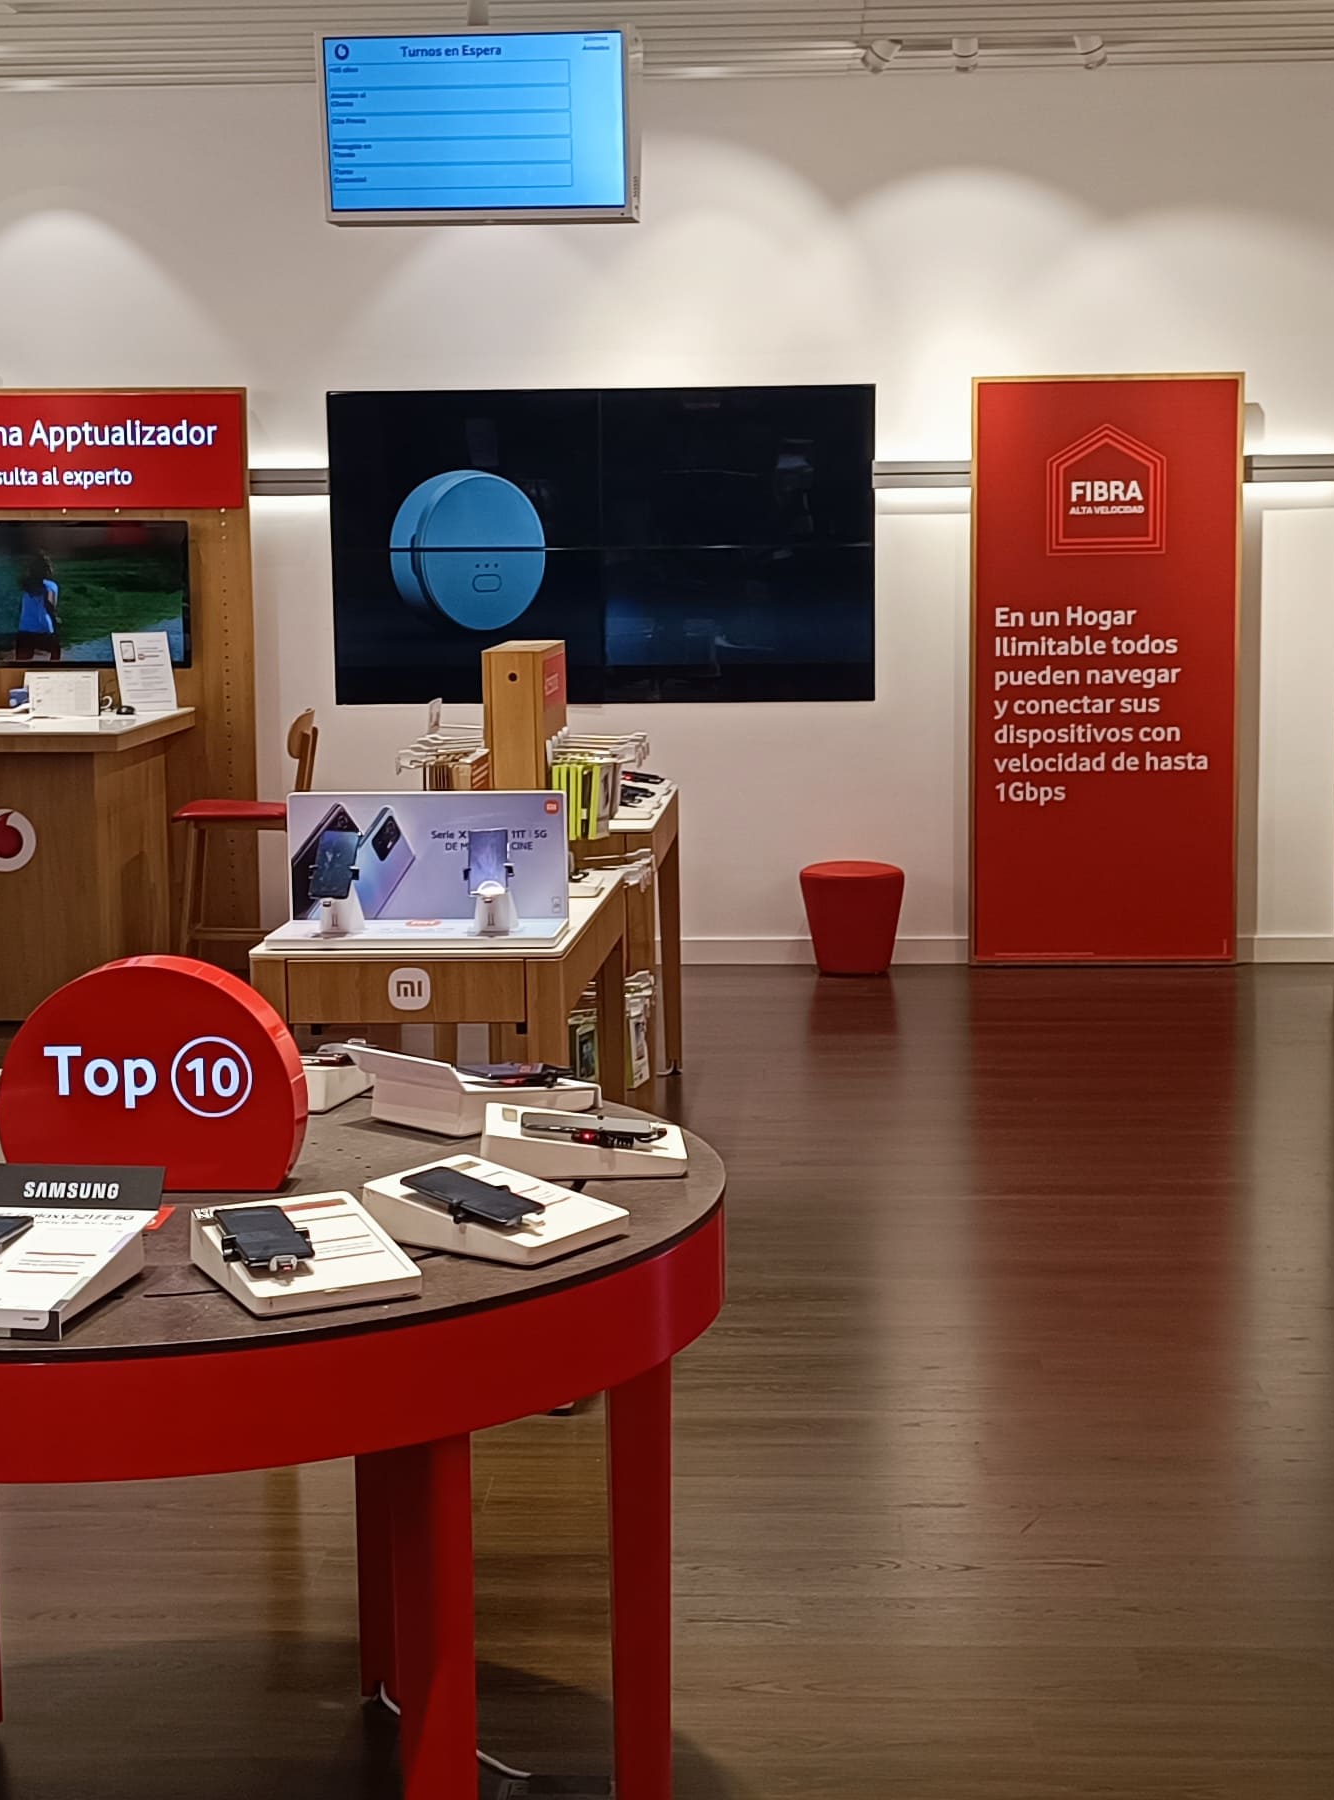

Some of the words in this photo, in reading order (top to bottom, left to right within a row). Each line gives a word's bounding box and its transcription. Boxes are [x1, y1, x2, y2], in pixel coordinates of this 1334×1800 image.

[399, 45, 442, 57] Turnos
[444, 48, 459, 56] en
[462, 45, 502, 58] Espera
[28, 419, 217, 453] Apptualizador
[42, 467, 59, 486] al
[63, 468, 133, 490] experto
[1071, 480, 1143, 502] FIBRA
[1069, 506, 1093, 515] ALTA
[1093, 505, 1145, 515] VELOCIDAD
[995, 607, 1024, 628] En
[1030, 610, 1060, 627] un
[1066, 605, 1137, 631] Hogar
[995, 635, 1107, 657] Ilimitable
[1111, 634, 1179, 655] todos
[994, 665, 1080, 691] pueden
[1086, 667, 1182, 689] navegar
[993, 699, 1009, 720] y
[1013, 696, 1116, 715] conectar
[1119, 697, 1160, 713] sus
[994, 723, 1134, 749] dispositivos
[1138, 725, 1181, 742] con
[994, 752, 1106, 773] velocidad
[1111, 751, 1139, 772] de
[1145, 751, 1209, 771] hasta
[995, 781, 1067, 807] 1Gbps
[430, 830, 455, 839] Serie
[534, 830, 547, 839] 5G
[445, 842, 458, 851] DE
[510, 842, 534, 851] CINE
[43, 1045, 158, 1110] Top
[185, 1057, 241, 1098] 10
[23, 1181, 120, 1200] SAMSUNG
